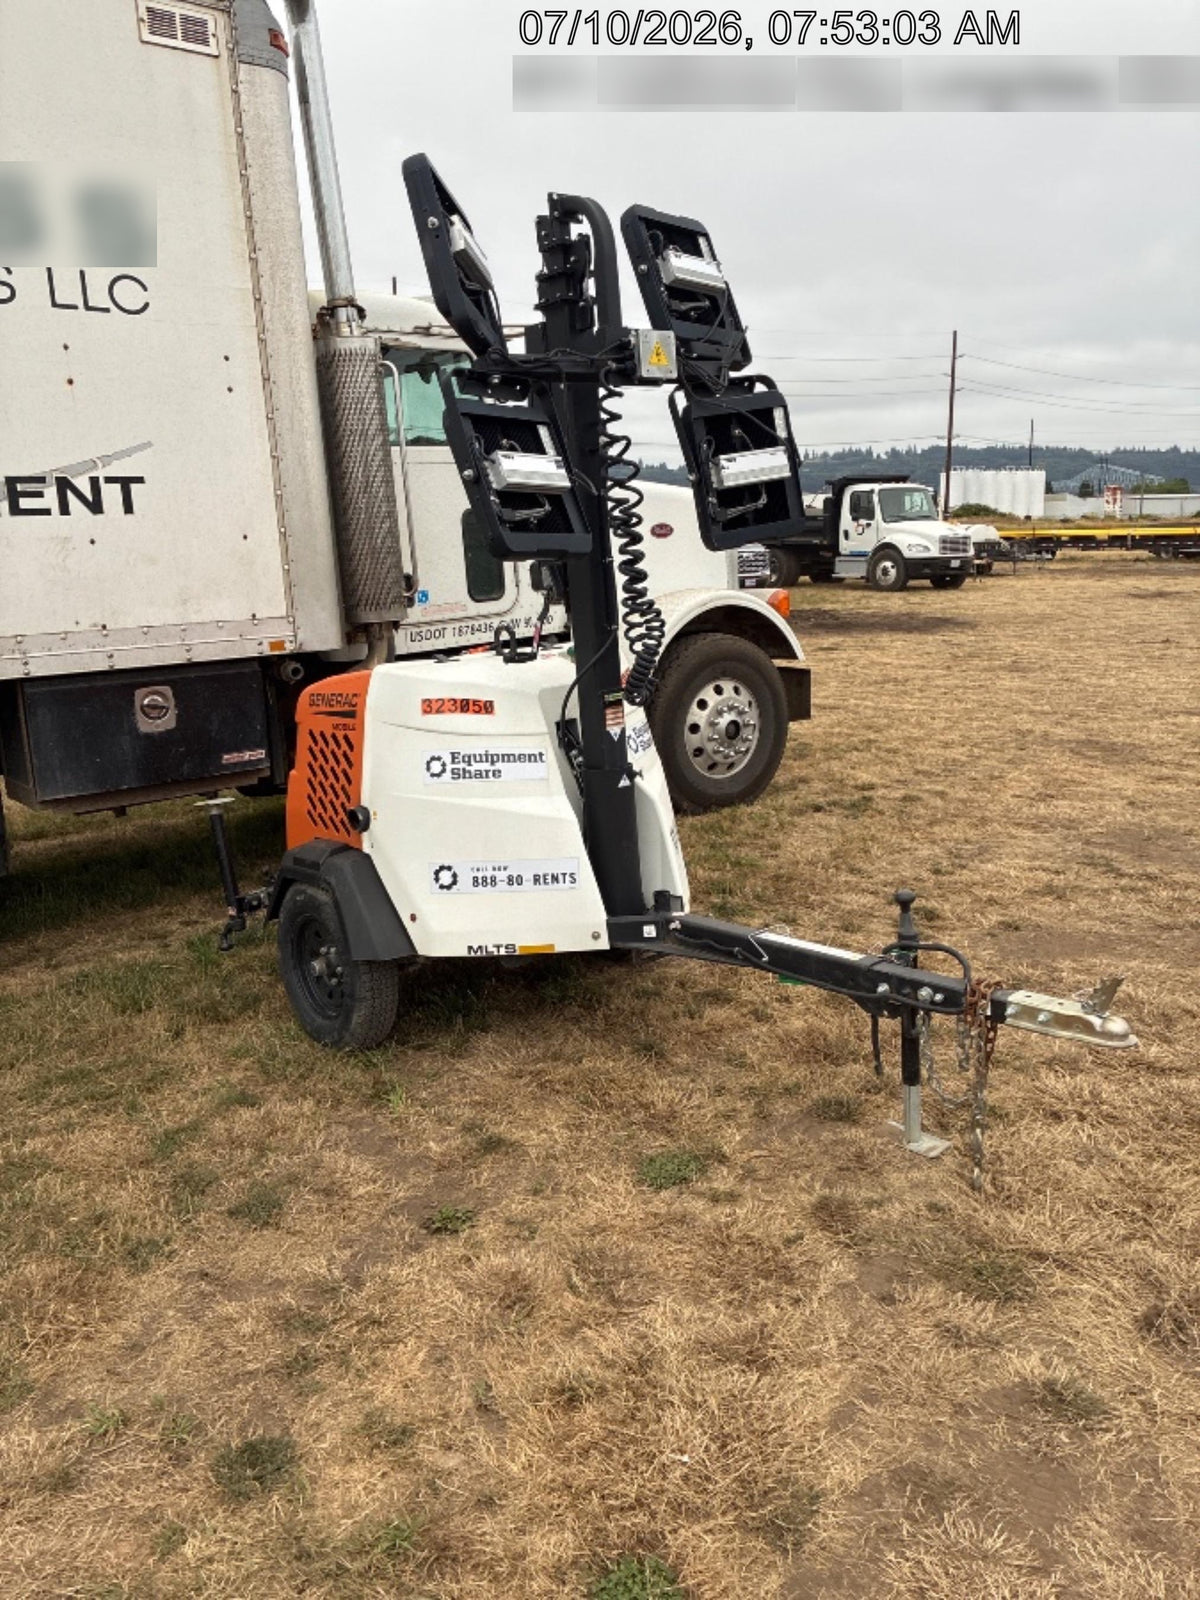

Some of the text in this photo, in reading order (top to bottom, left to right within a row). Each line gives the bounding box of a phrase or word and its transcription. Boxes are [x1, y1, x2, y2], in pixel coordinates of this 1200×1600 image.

[46, 267, 150, 315] LLC
[0, 476, 146, 516] ENT
[410, 627, 447, 642] USDOT
[308, 693, 358, 708] GENERAC
[422, 698, 494, 714] 323050
[449, 750, 546, 767] Equipment
[450, 767, 502, 780] Share
[467, 943, 517, 955] MLTS
